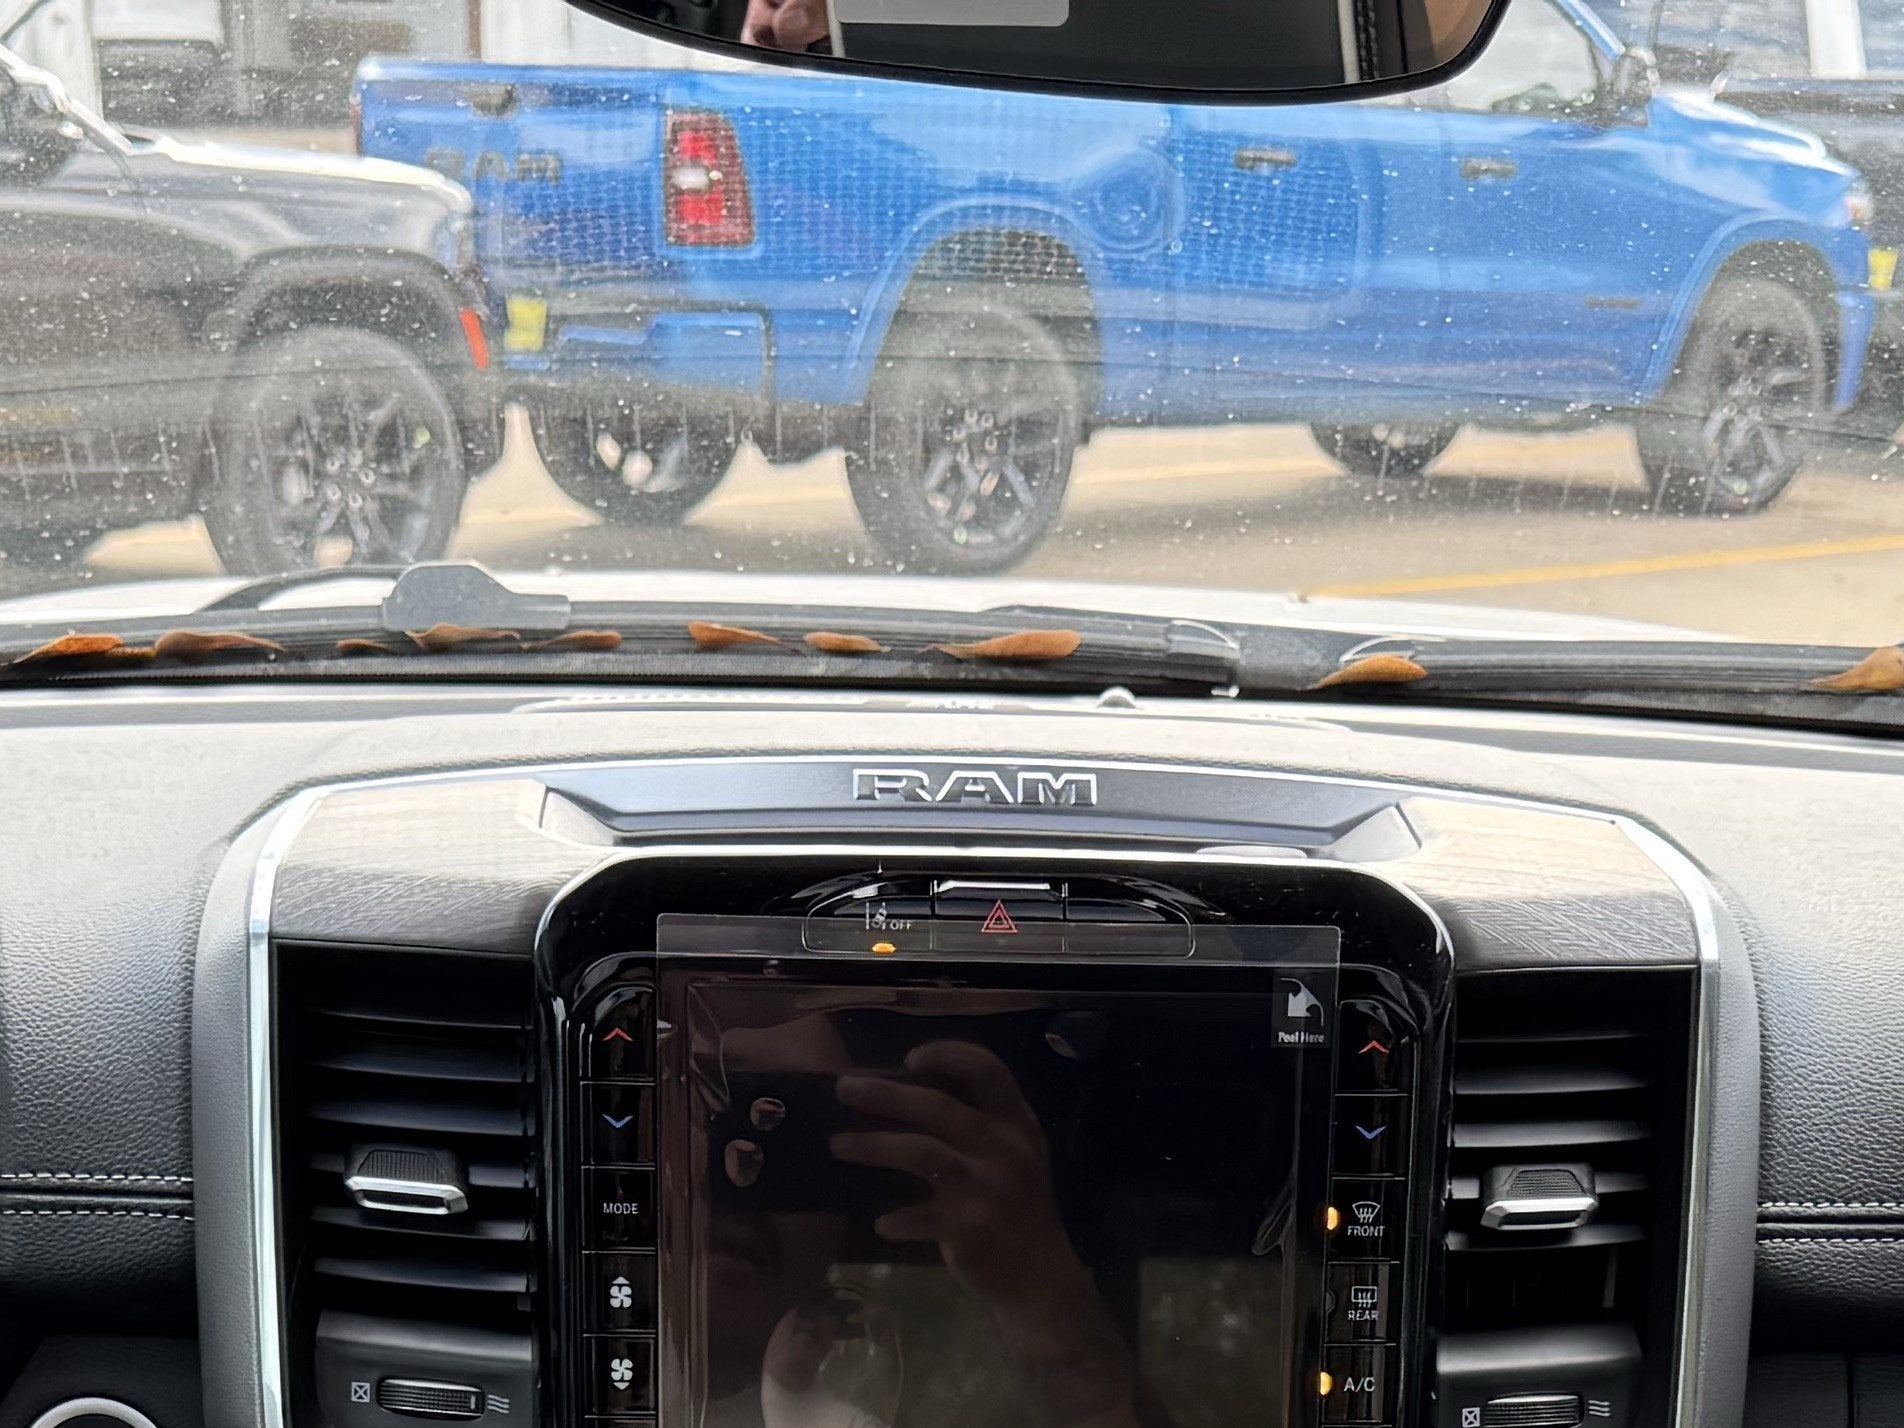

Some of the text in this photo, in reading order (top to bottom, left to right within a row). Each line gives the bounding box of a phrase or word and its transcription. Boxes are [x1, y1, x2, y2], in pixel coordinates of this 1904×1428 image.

[852, 768, 1098, 807] RAM
[889, 919, 913, 931] OFF
[603, 1202, 639, 1215] MODE
[1347, 1225, 1386, 1238] FRONT
[1347, 1310, 1380, 1322] REAR
[1343, 1376, 1376, 1393] A/C
